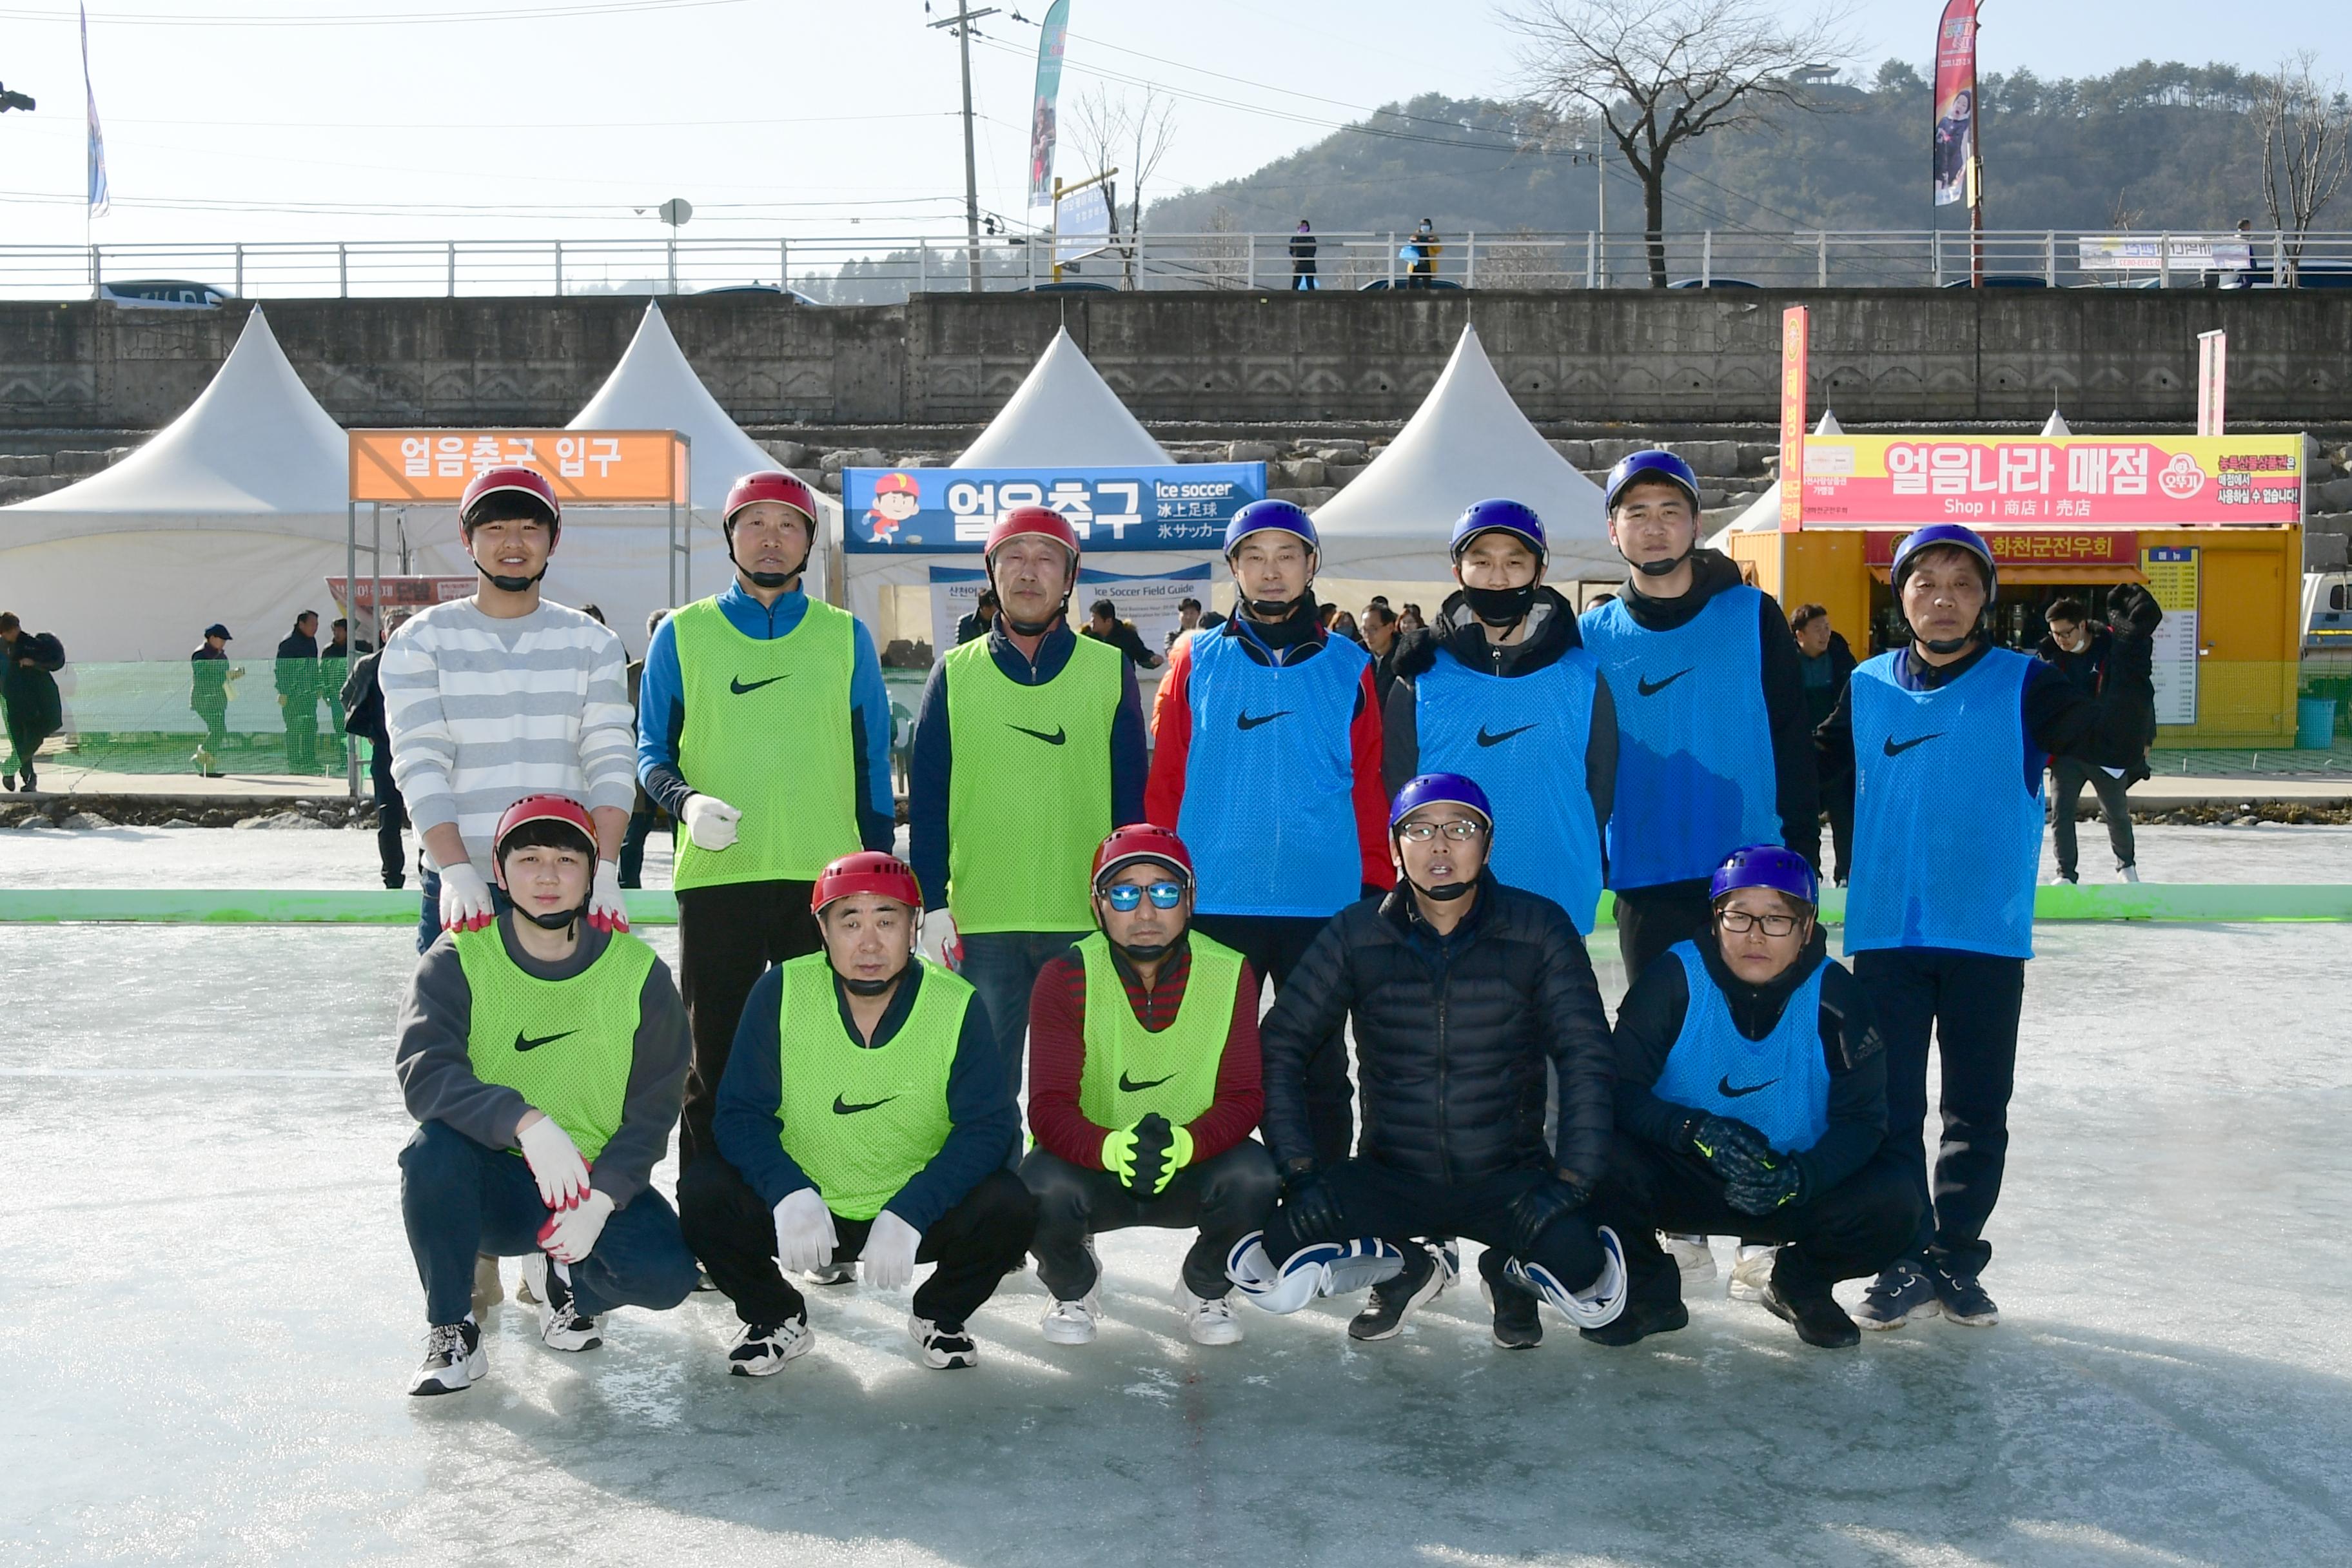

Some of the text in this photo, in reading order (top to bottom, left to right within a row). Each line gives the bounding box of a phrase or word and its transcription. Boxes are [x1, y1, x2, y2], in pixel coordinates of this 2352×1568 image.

[401, 436, 622, 477] 얼음축구 입구
[2219, 455, 2295, 471] 농특산물상품권은
[1888, 446, 2055, 495] 얼음나라
[2068, 447, 2148, 495] 매점
[2165, 475, 2197, 488] 오뚜기
[2218, 473, 2250, 487] 매점에서
[1156, 482, 1233, 498] Ice soccer
[1813, 486, 1834, 495] 가맹점
[2218, 487, 2298, 504] 사용하실 수 없습니다!
[1945, 498, 1983, 516] Shop
[2004, 499, 2037, 516] 商店
[2056, 498, 2091, 516] 売店
[1992, 536, 2112, 558] 화천군전우회
[1095, 584, 1194, 596] Ice Soccer Field Guide
